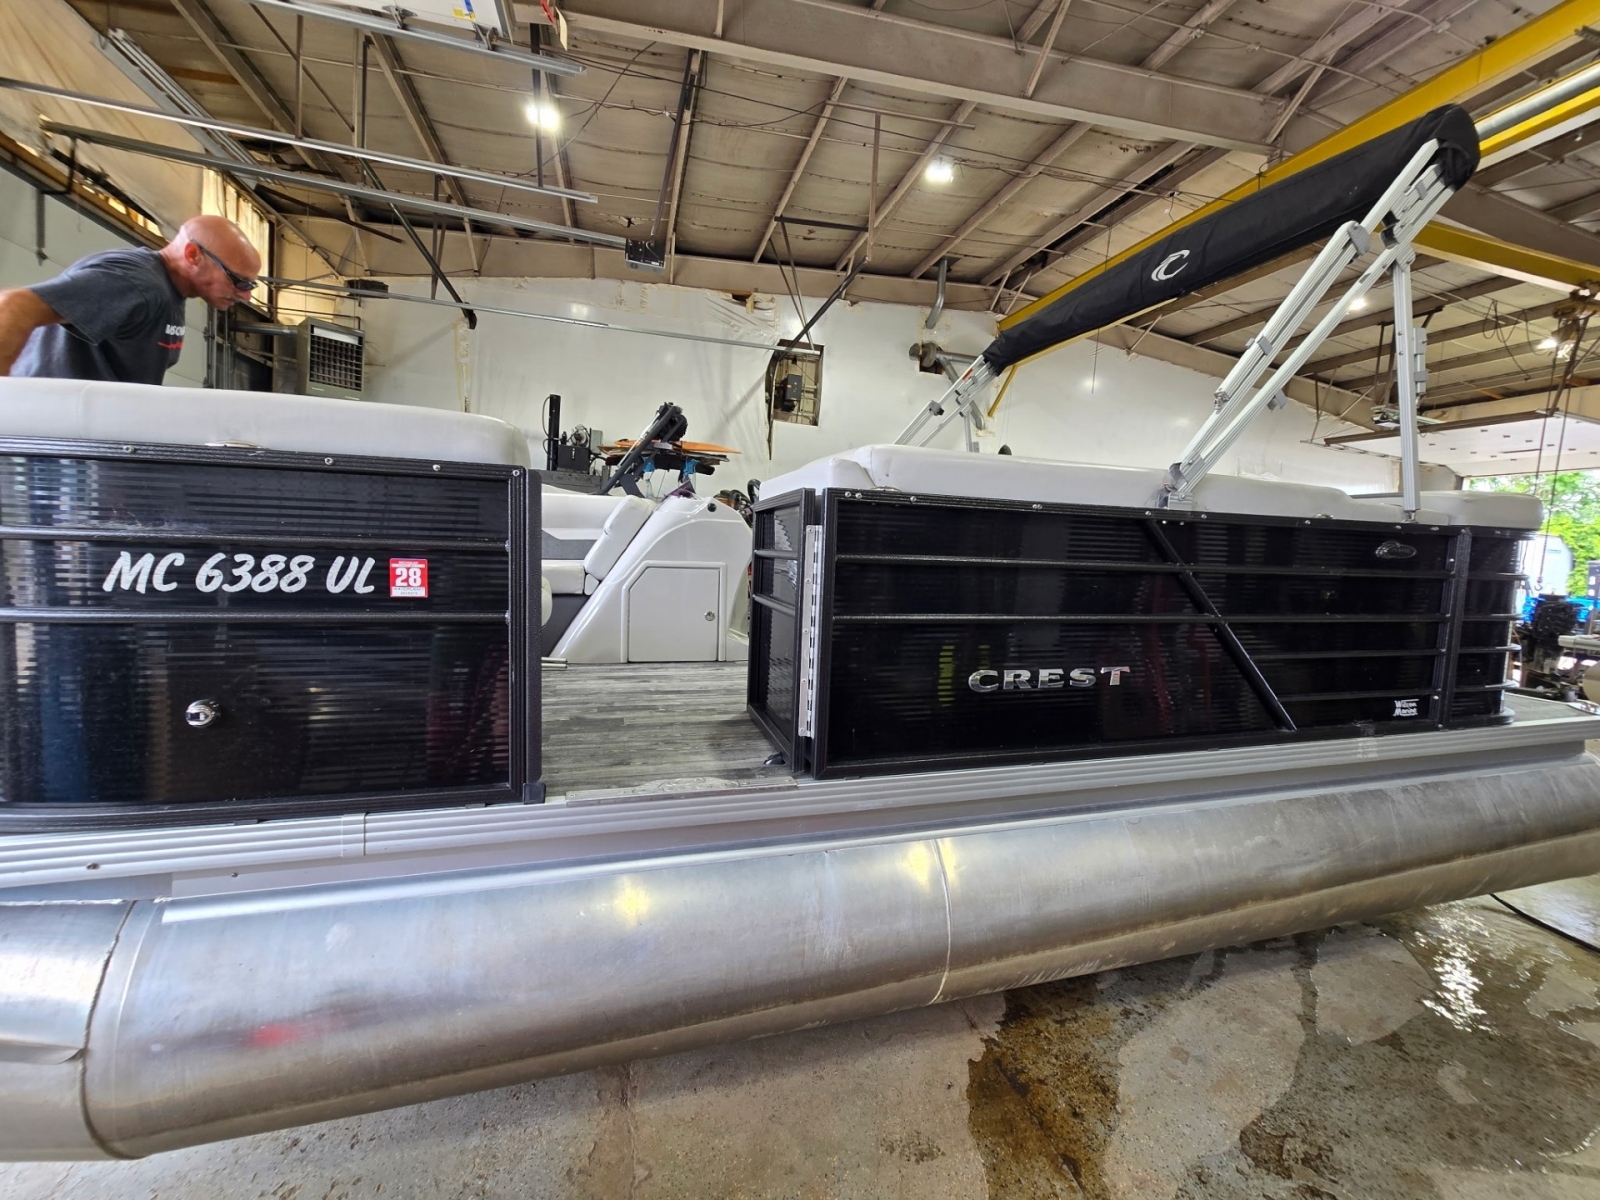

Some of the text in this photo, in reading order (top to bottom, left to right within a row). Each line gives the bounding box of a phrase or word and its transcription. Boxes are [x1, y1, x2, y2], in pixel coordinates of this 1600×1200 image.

[102, 551, 376, 594] MC 6388 UL
[395, 567, 422, 587] 28
[968, 666, 1131, 693] CREST
